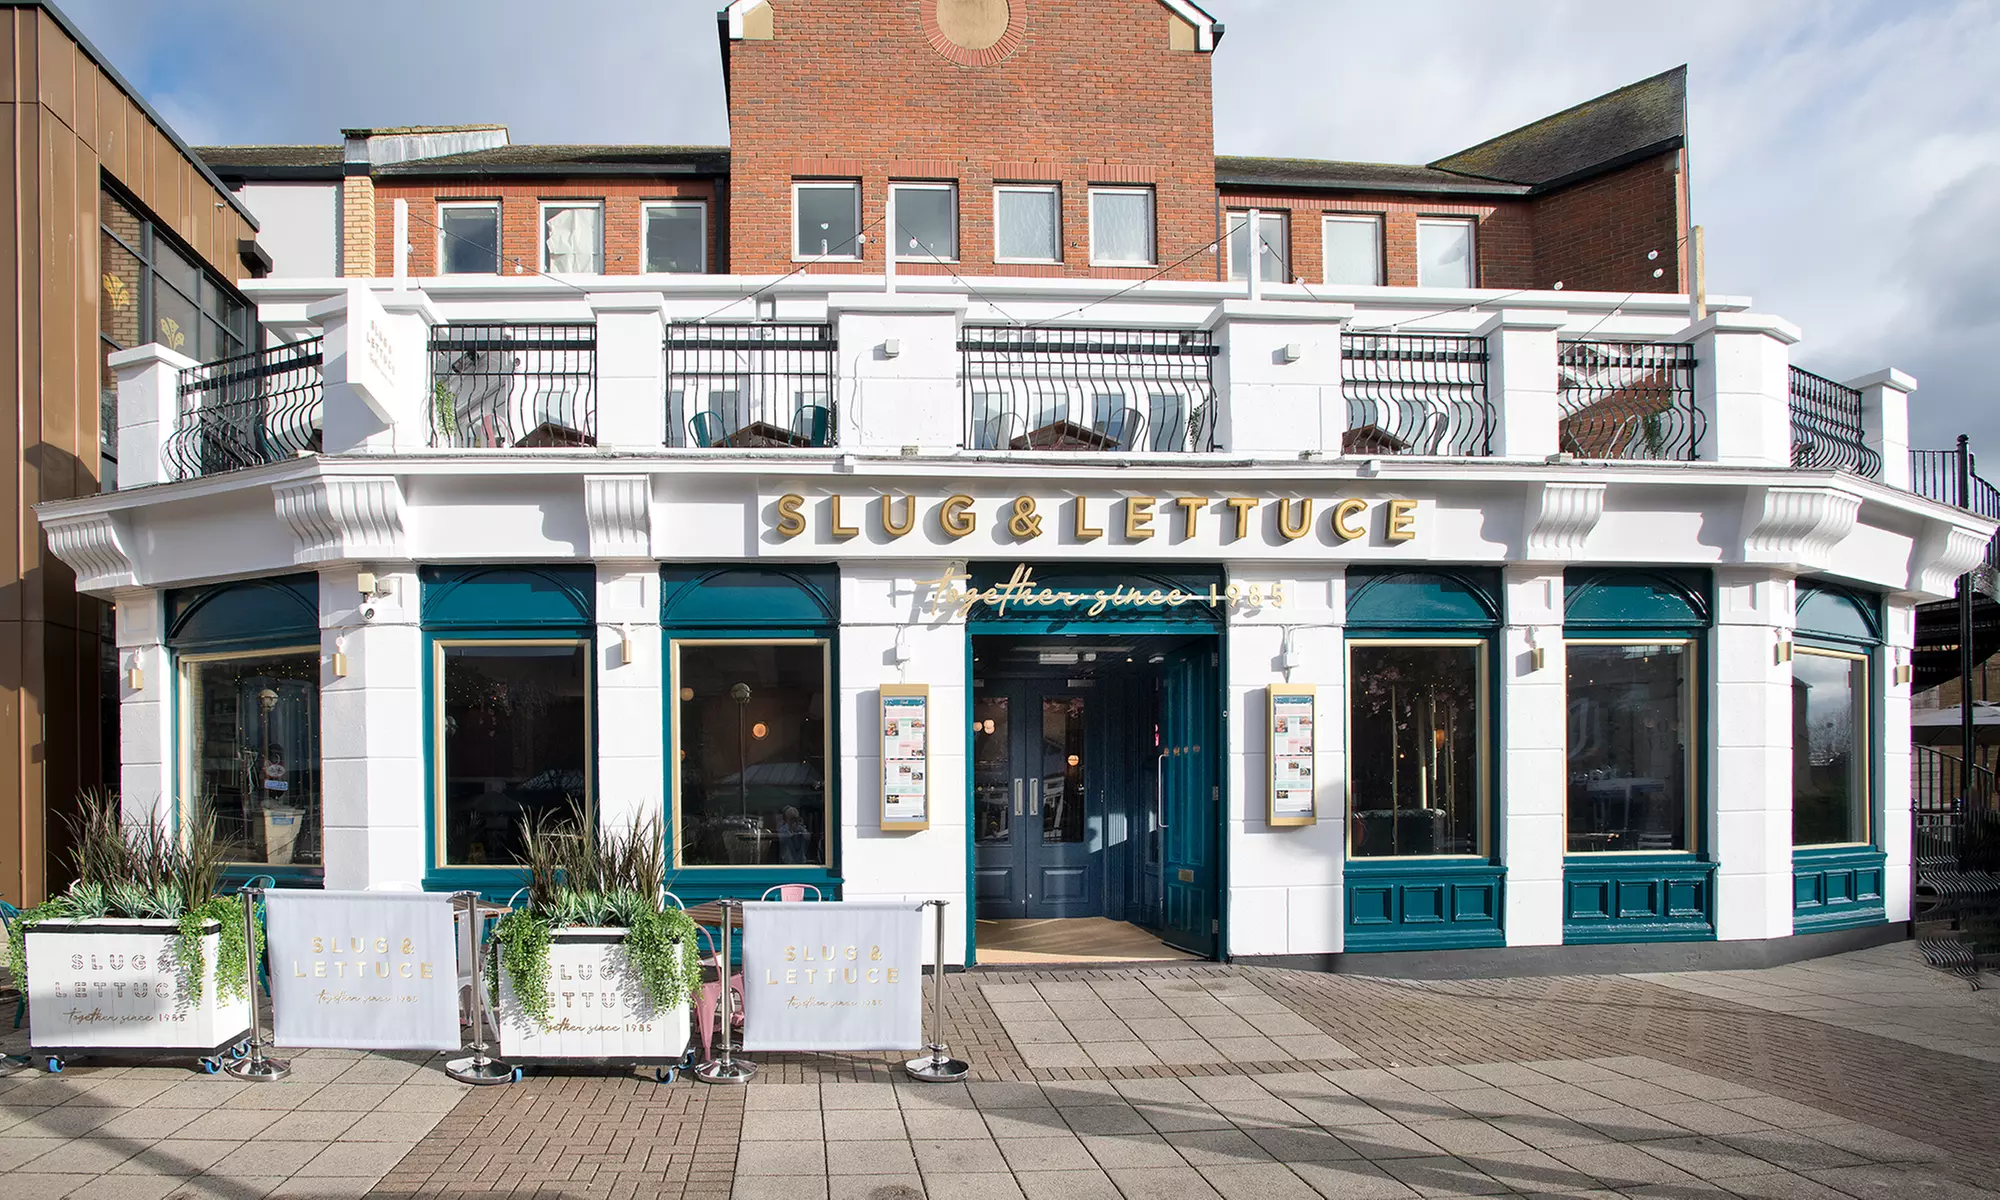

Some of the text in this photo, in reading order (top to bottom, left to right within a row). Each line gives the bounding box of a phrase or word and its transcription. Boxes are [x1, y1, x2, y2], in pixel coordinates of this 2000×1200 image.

[776, 493, 1418, 541] SLUG & LETTUCE
[915, 562, 1285, 617] together since 1985
[311, 936, 415, 955] SLUG &
[784, 944, 883, 961] SLUG &
[71, 953, 147, 970] SLUG
[293, 960, 434, 979] LETTUCE
[766, 967, 900, 985] LETTUCE
[55, 981, 170, 998] LETTUC
[62, 1007, 188, 1024] together since 1985
[586, 1023, 621, 1034] since
[625, 1023, 653, 1032] 1985
